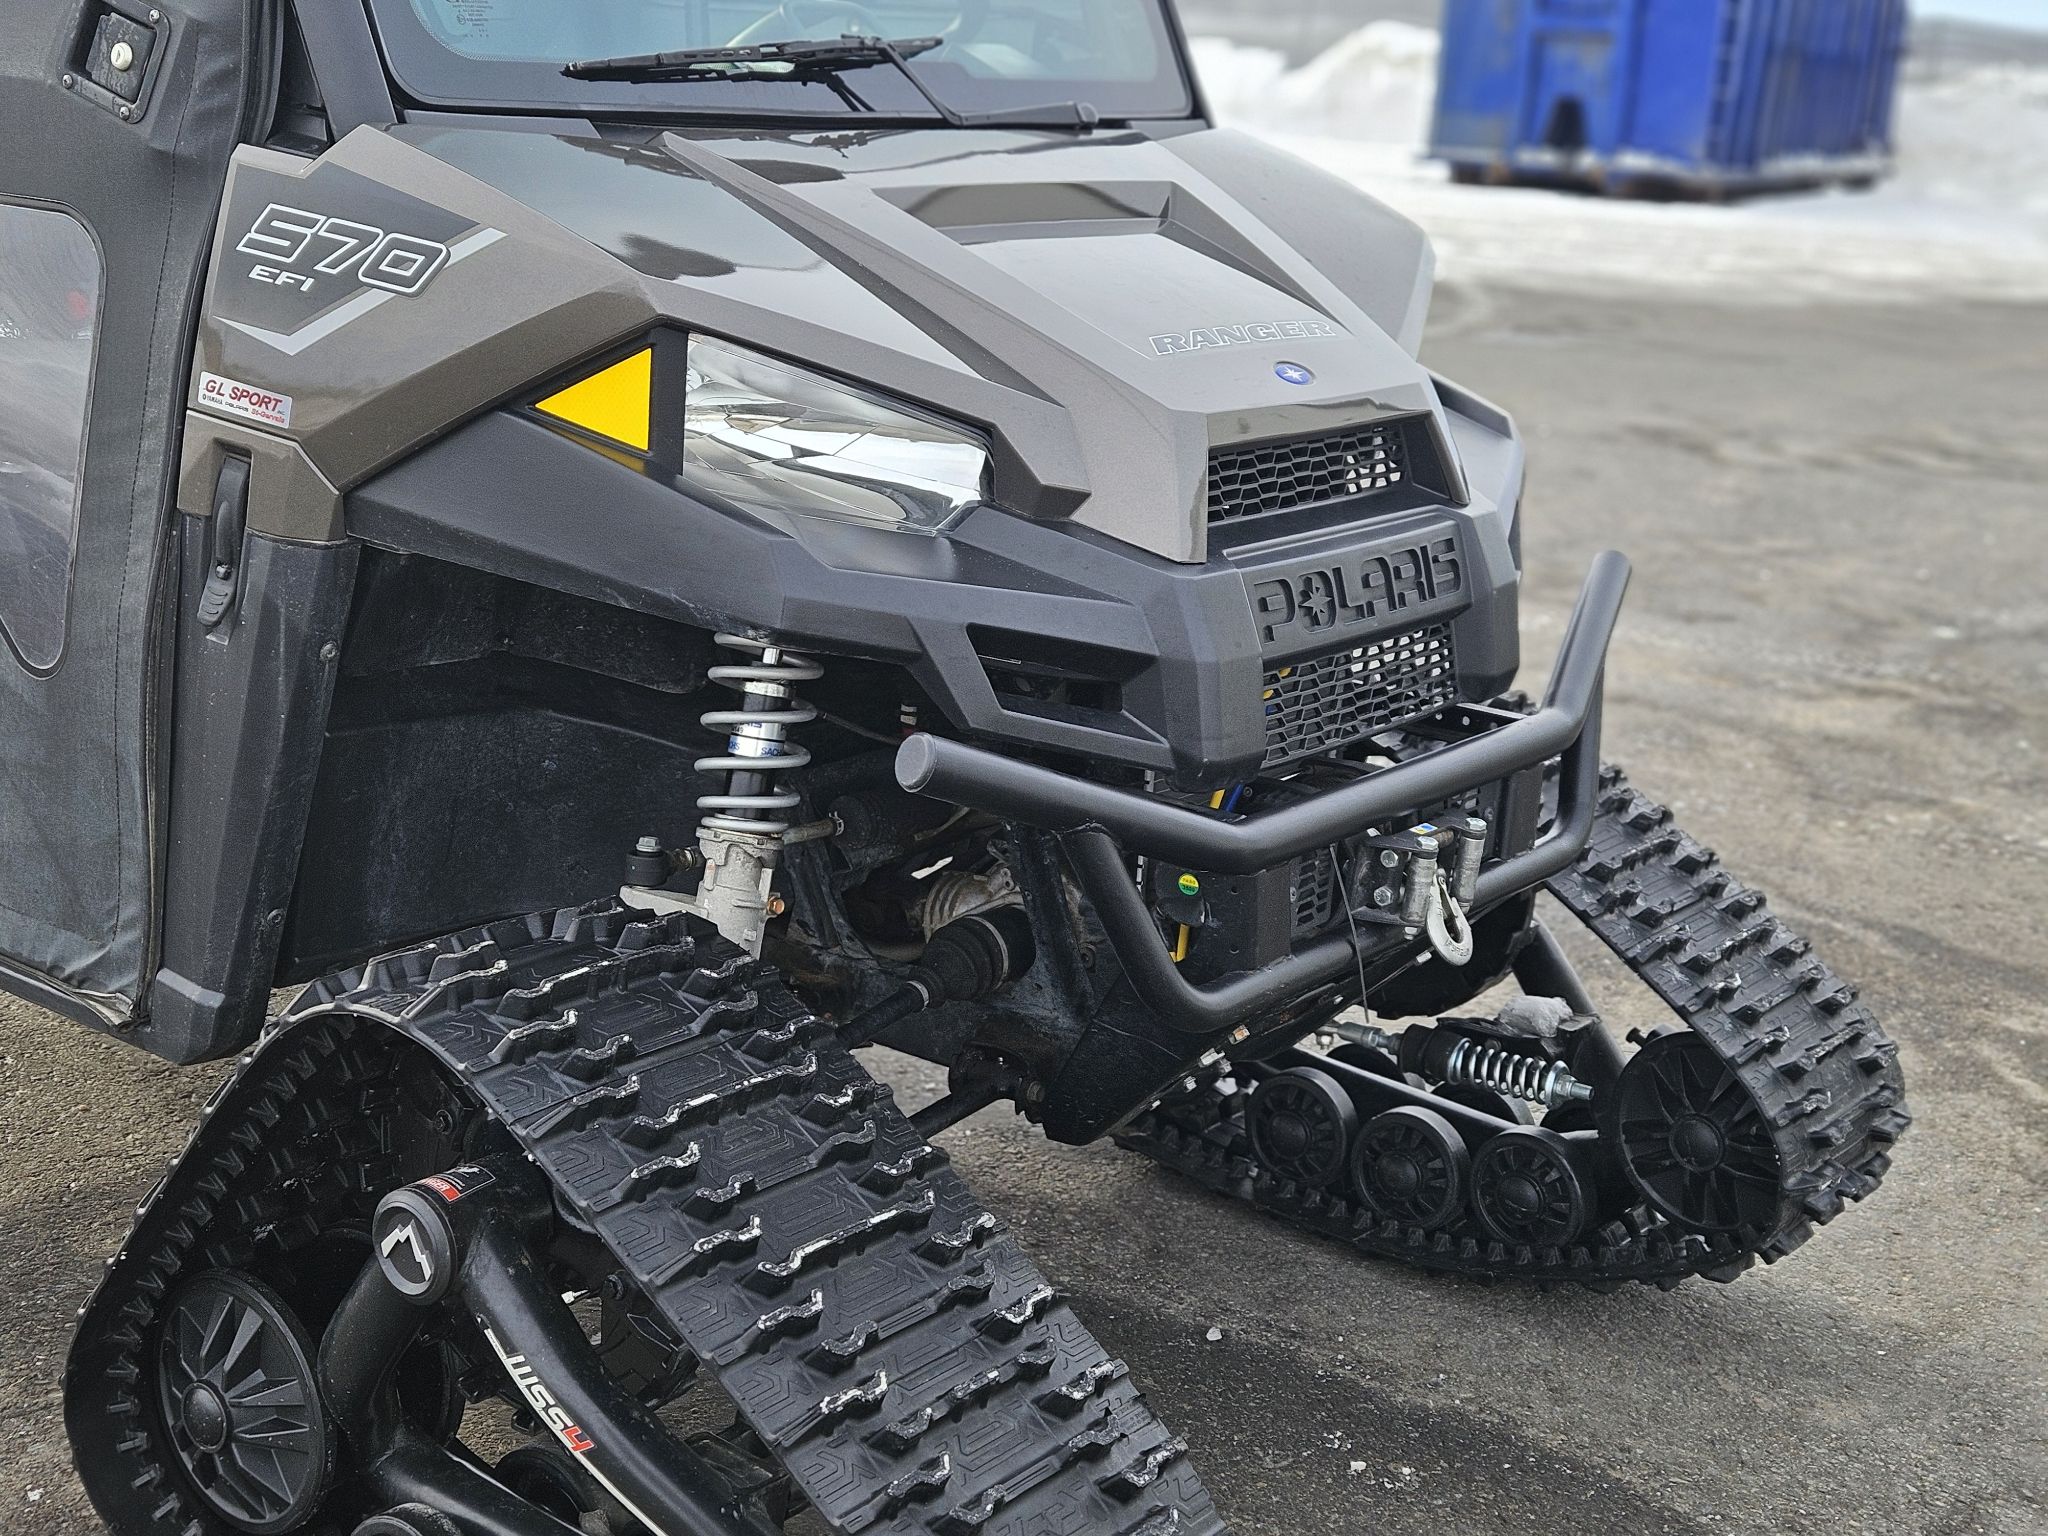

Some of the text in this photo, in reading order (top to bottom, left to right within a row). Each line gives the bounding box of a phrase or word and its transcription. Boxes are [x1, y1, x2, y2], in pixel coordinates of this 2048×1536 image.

[236, 203, 450, 295] 570
[248, 264, 315, 291] EFI
[1149, 320, 1336, 356] RANGER
[205, 379, 225, 397] GL
[229, 386, 283, 412] SPORT
[1254, 537, 1462, 644] POLARIS
